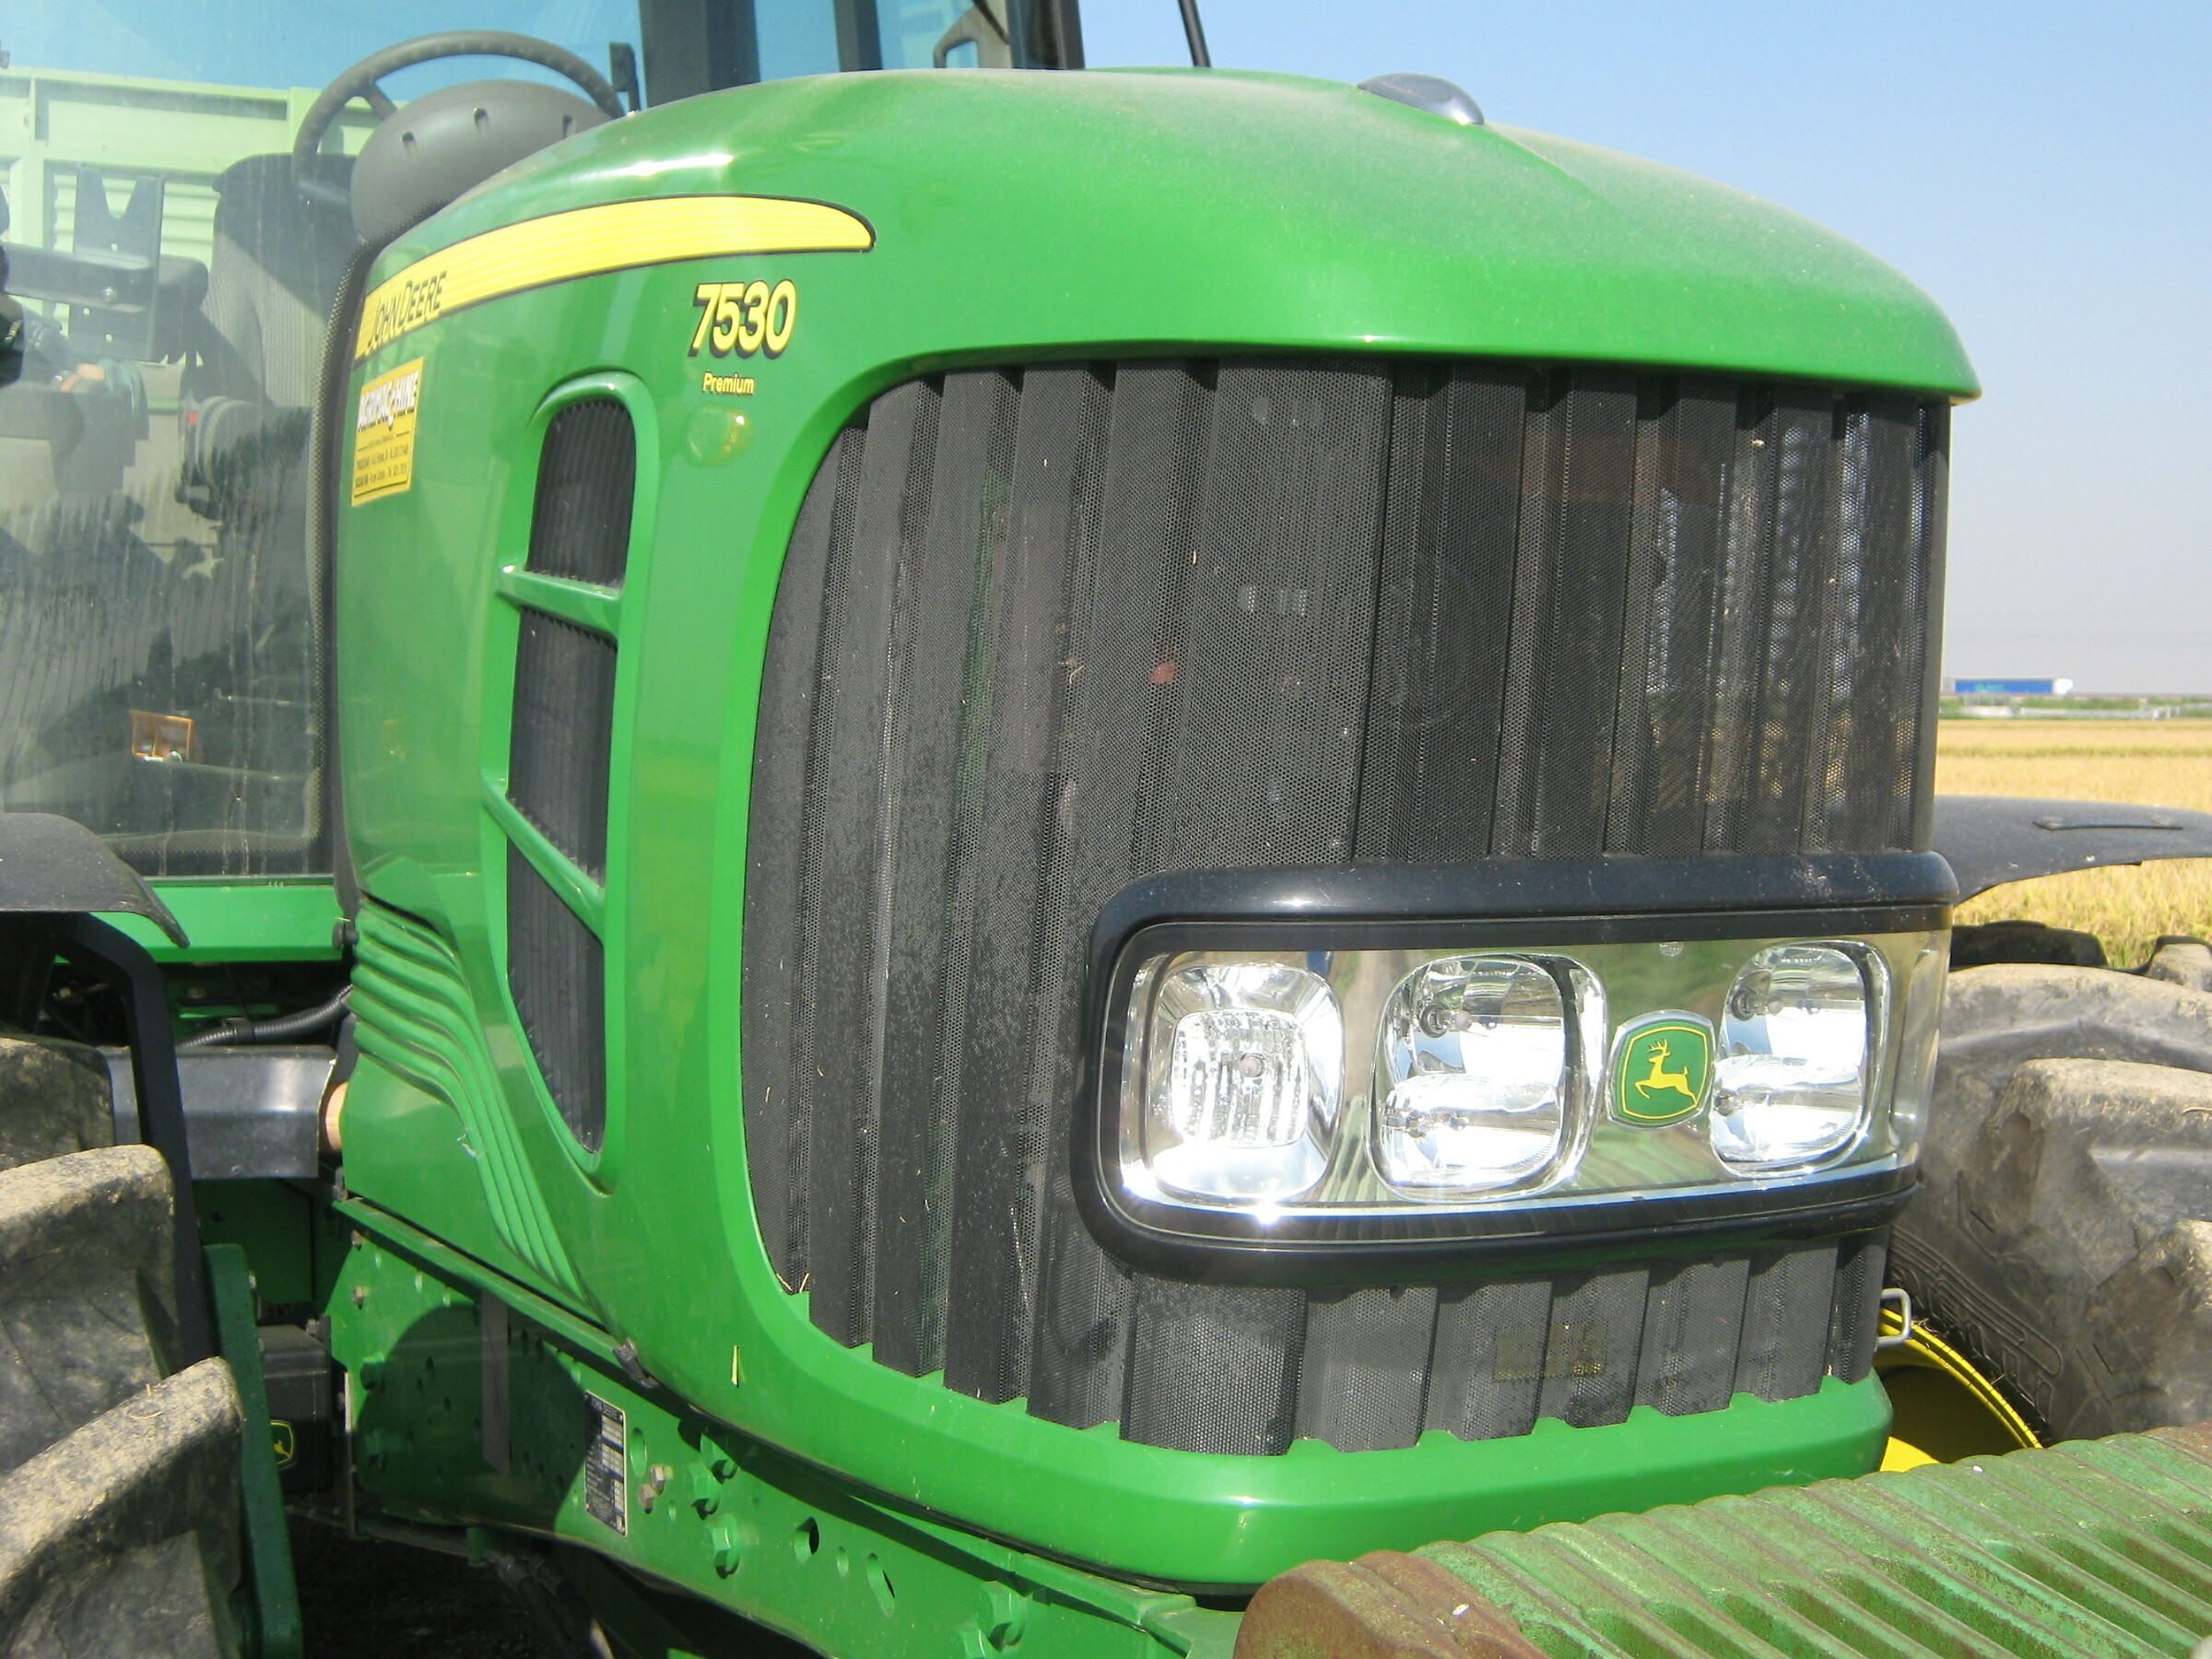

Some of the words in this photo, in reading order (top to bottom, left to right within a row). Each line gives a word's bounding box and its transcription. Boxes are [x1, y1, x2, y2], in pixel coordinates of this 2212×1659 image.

[367, 292, 403, 347] JOHN
[398, 270, 447, 327] DEERE
[688, 278, 797, 359] 7530
[702, 371, 755, 395] Premium
